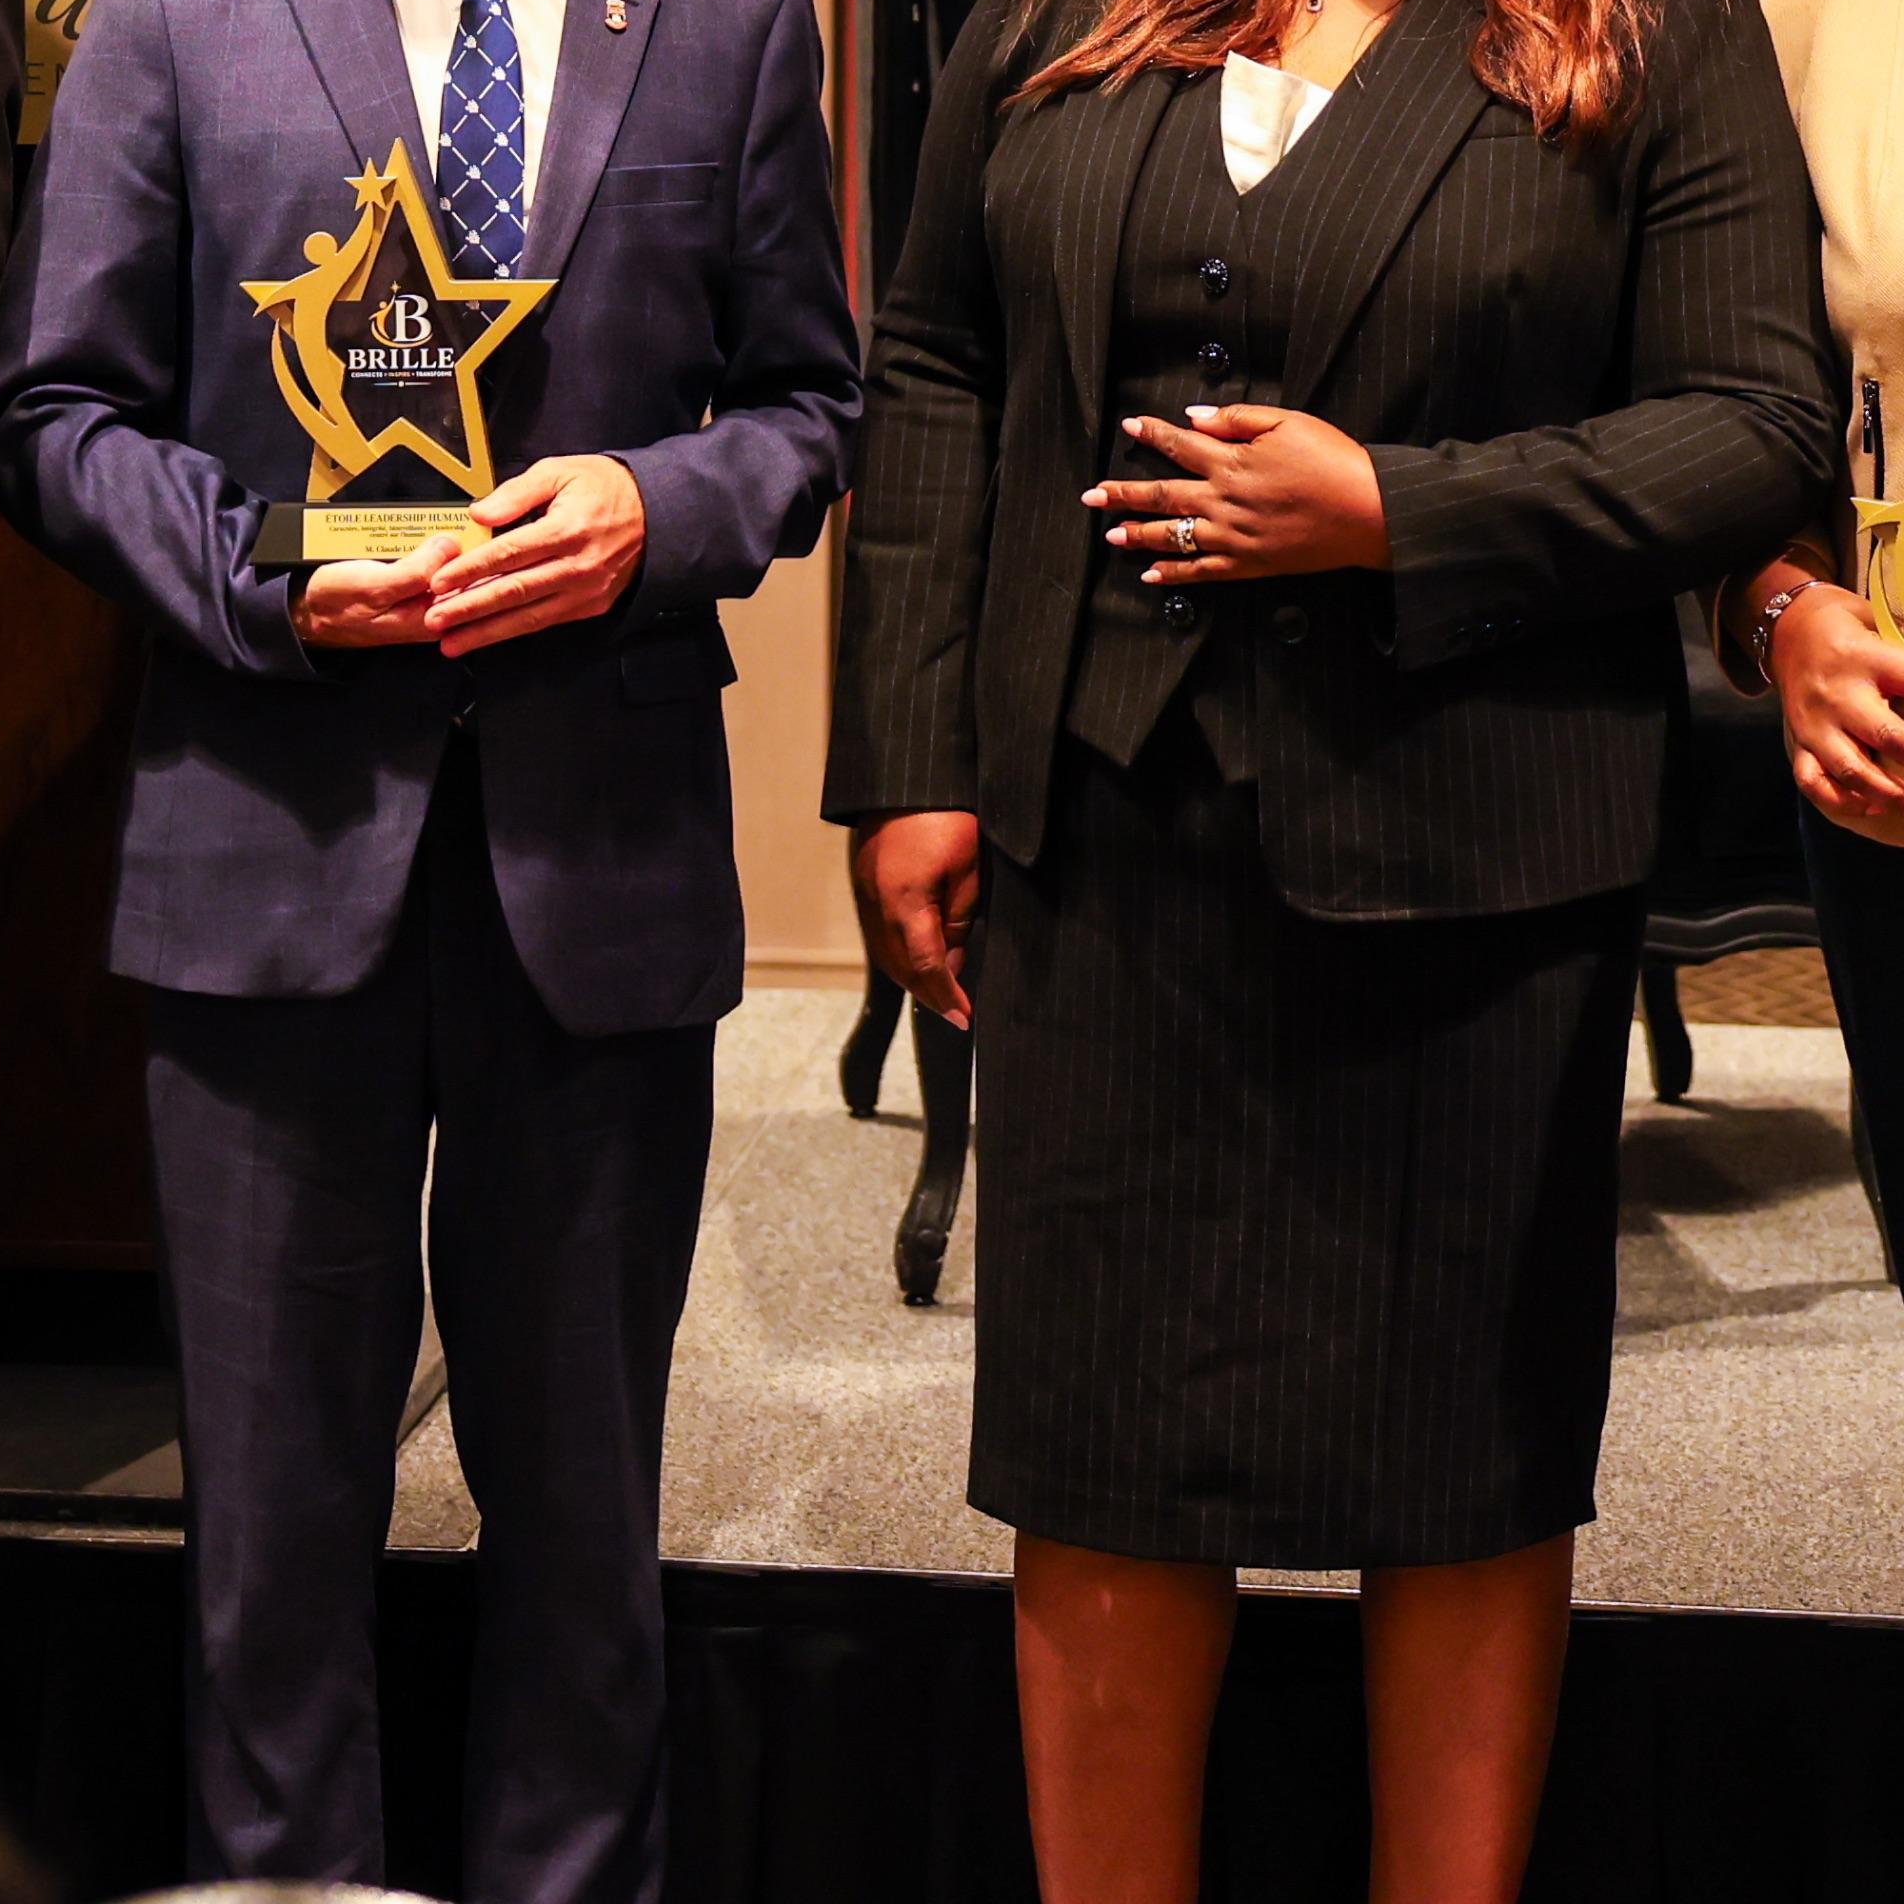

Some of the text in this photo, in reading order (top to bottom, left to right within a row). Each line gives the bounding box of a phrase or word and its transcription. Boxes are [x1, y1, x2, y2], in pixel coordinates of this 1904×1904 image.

[347, 347, 455, 370] BRILLE
[325, 512, 470, 523] ÉTOILE LEADERSHIP HUMAIN
[376, 545, 401, 553] Claude
